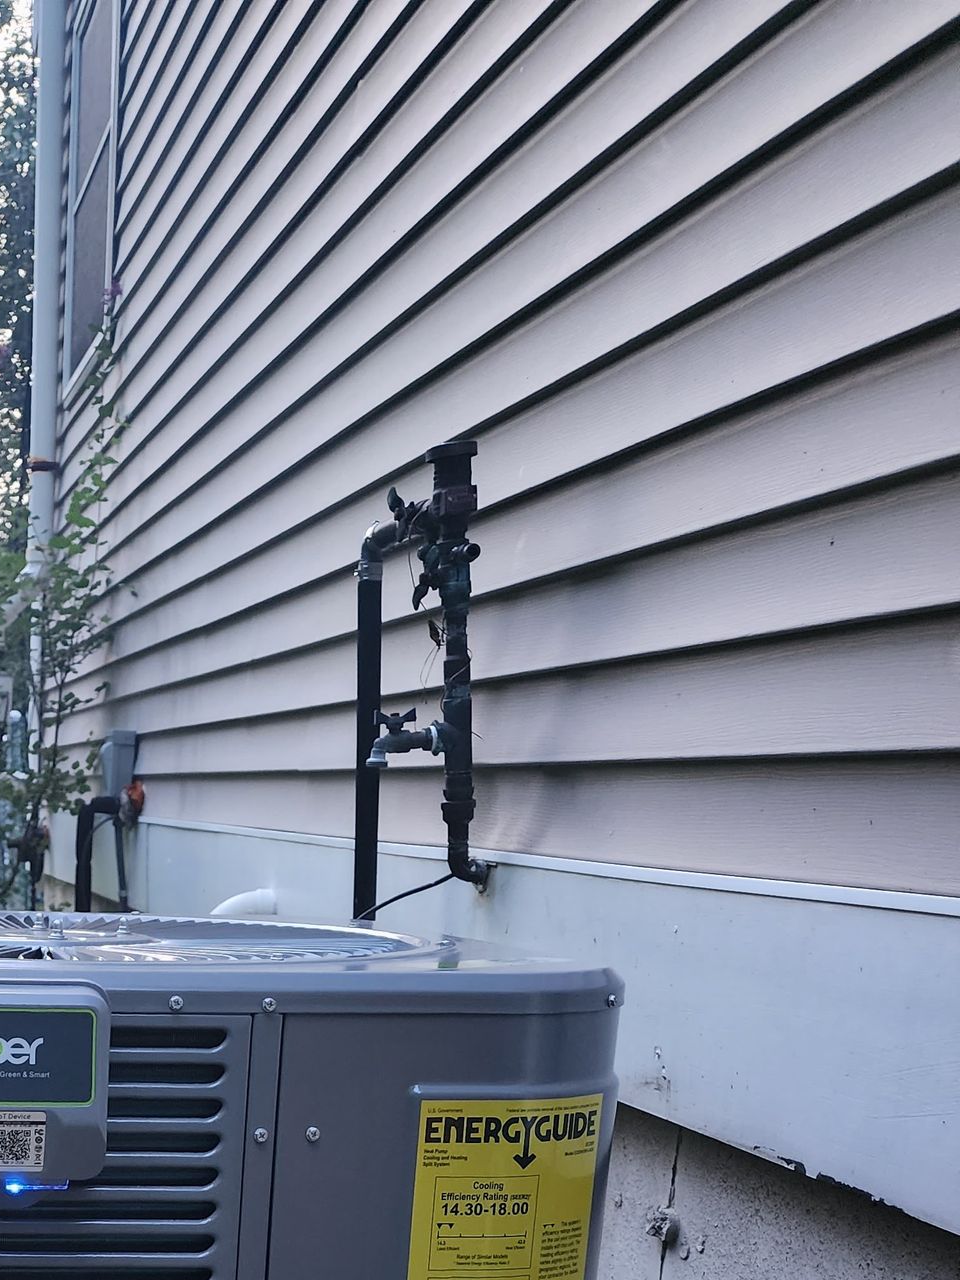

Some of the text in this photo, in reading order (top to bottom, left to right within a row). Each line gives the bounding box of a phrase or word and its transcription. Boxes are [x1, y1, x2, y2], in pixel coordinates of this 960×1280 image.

[425, 1110, 597, 1144] ENERGYGUIDE
[473, 1181, 504, 1191] Cooling
[441, 1192, 508, 1202] Efficiency Rating
[442, 1202, 529, 1216] 14.30-18.00
